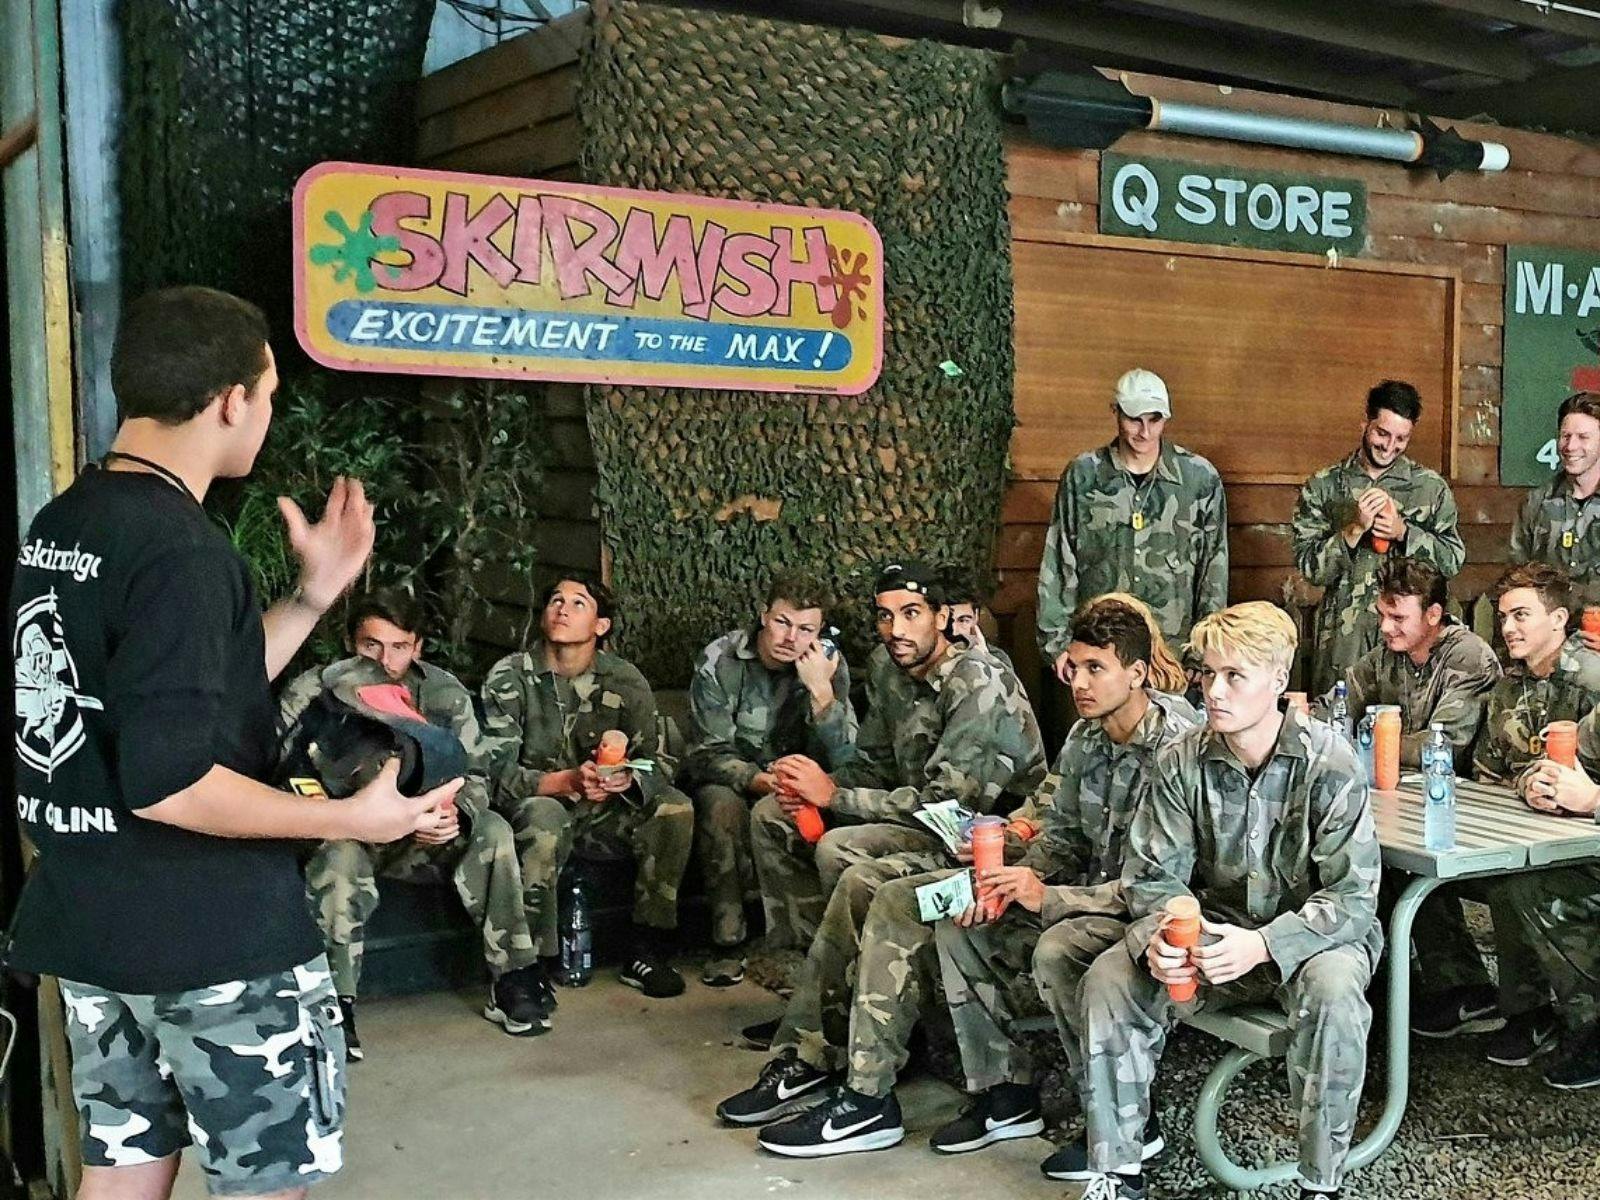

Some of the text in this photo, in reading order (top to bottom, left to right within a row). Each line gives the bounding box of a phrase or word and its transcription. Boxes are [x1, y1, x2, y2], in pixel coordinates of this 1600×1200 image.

[1112, 163, 1353, 238] Q STORE
[368, 190, 839, 321] SKIRMISH
[349, 308, 619, 351] EXCITEMENT
[634, 331, 664, 349] TO
[668, 333, 709, 353] THE
